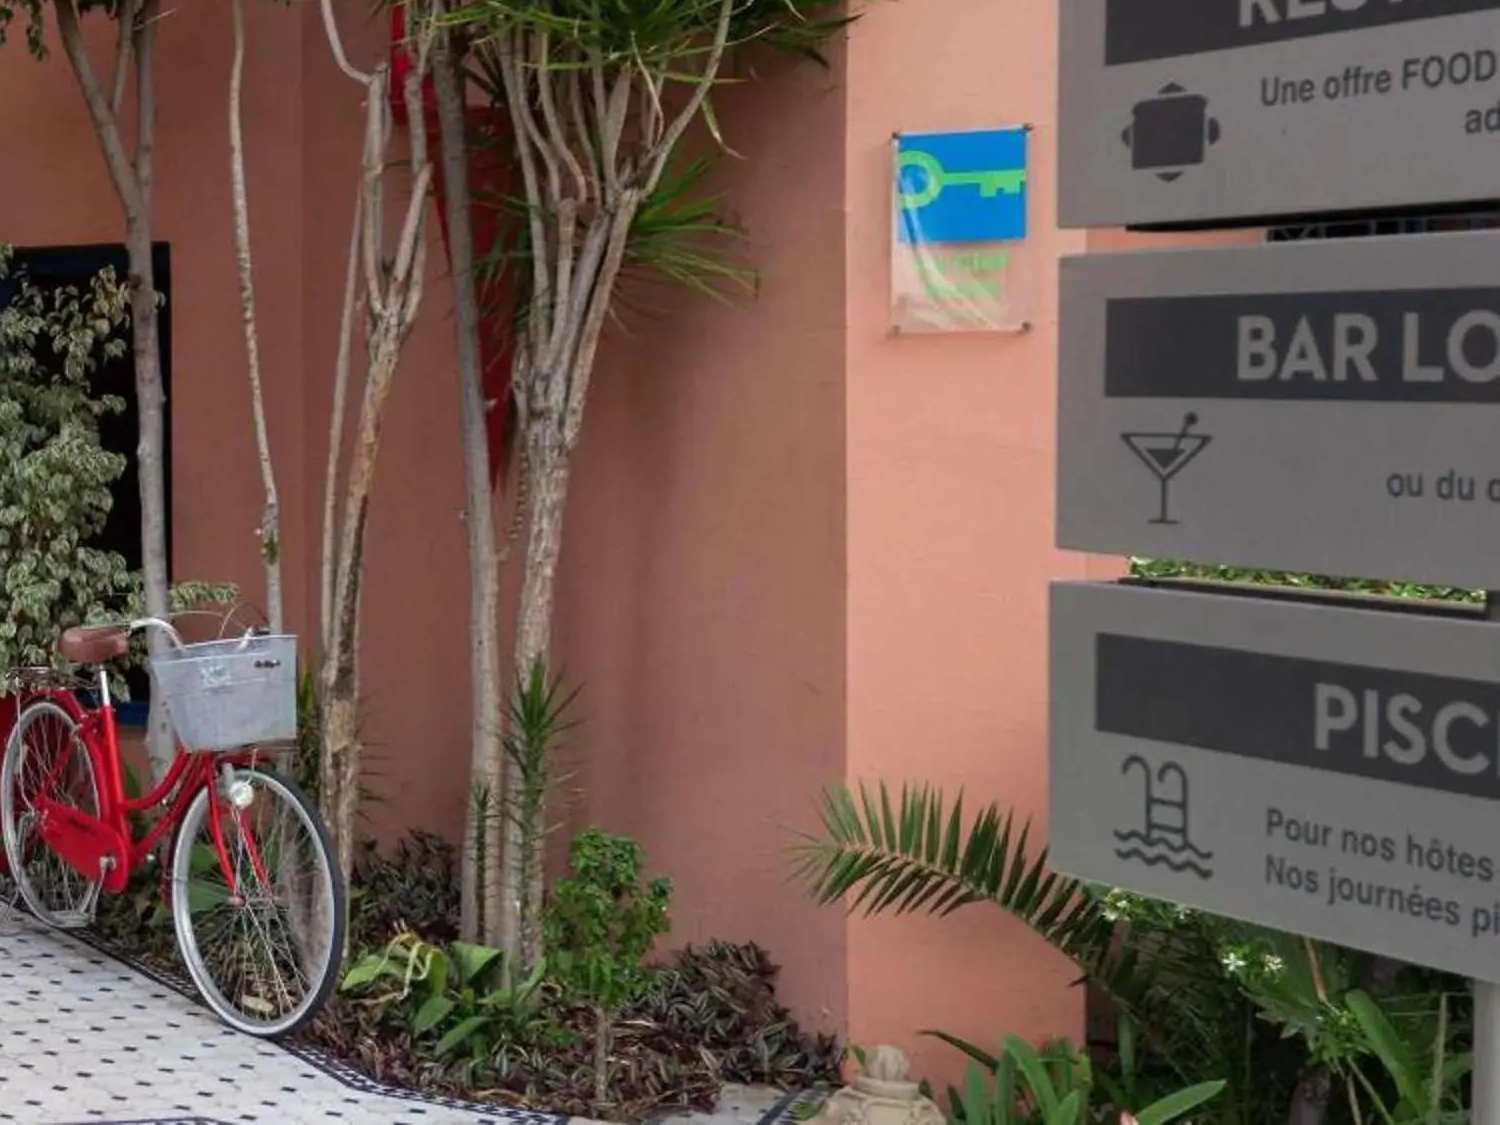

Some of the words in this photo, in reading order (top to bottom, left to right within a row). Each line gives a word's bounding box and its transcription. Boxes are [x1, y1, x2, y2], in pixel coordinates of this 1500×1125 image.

[1261, 76, 1315, 107] Une
[1323, 65, 1392, 100] offre
[1402, 49, 1497, 91] FOOD
[1237, 312, 1380, 381] BAR
[1402, 309, 1500, 383] LO
[1386, 472, 1424, 498] ou
[1436, 468, 1475, 502] du
[1314, 683, 1500, 775] PISC
[1266, 807, 1333, 848] Pour
[1341, 827, 1395, 862] nos
[1406, 832, 1494, 882] hôtes
[1265, 854, 1319, 894] Nos
[1326, 868, 1461, 926] journées
